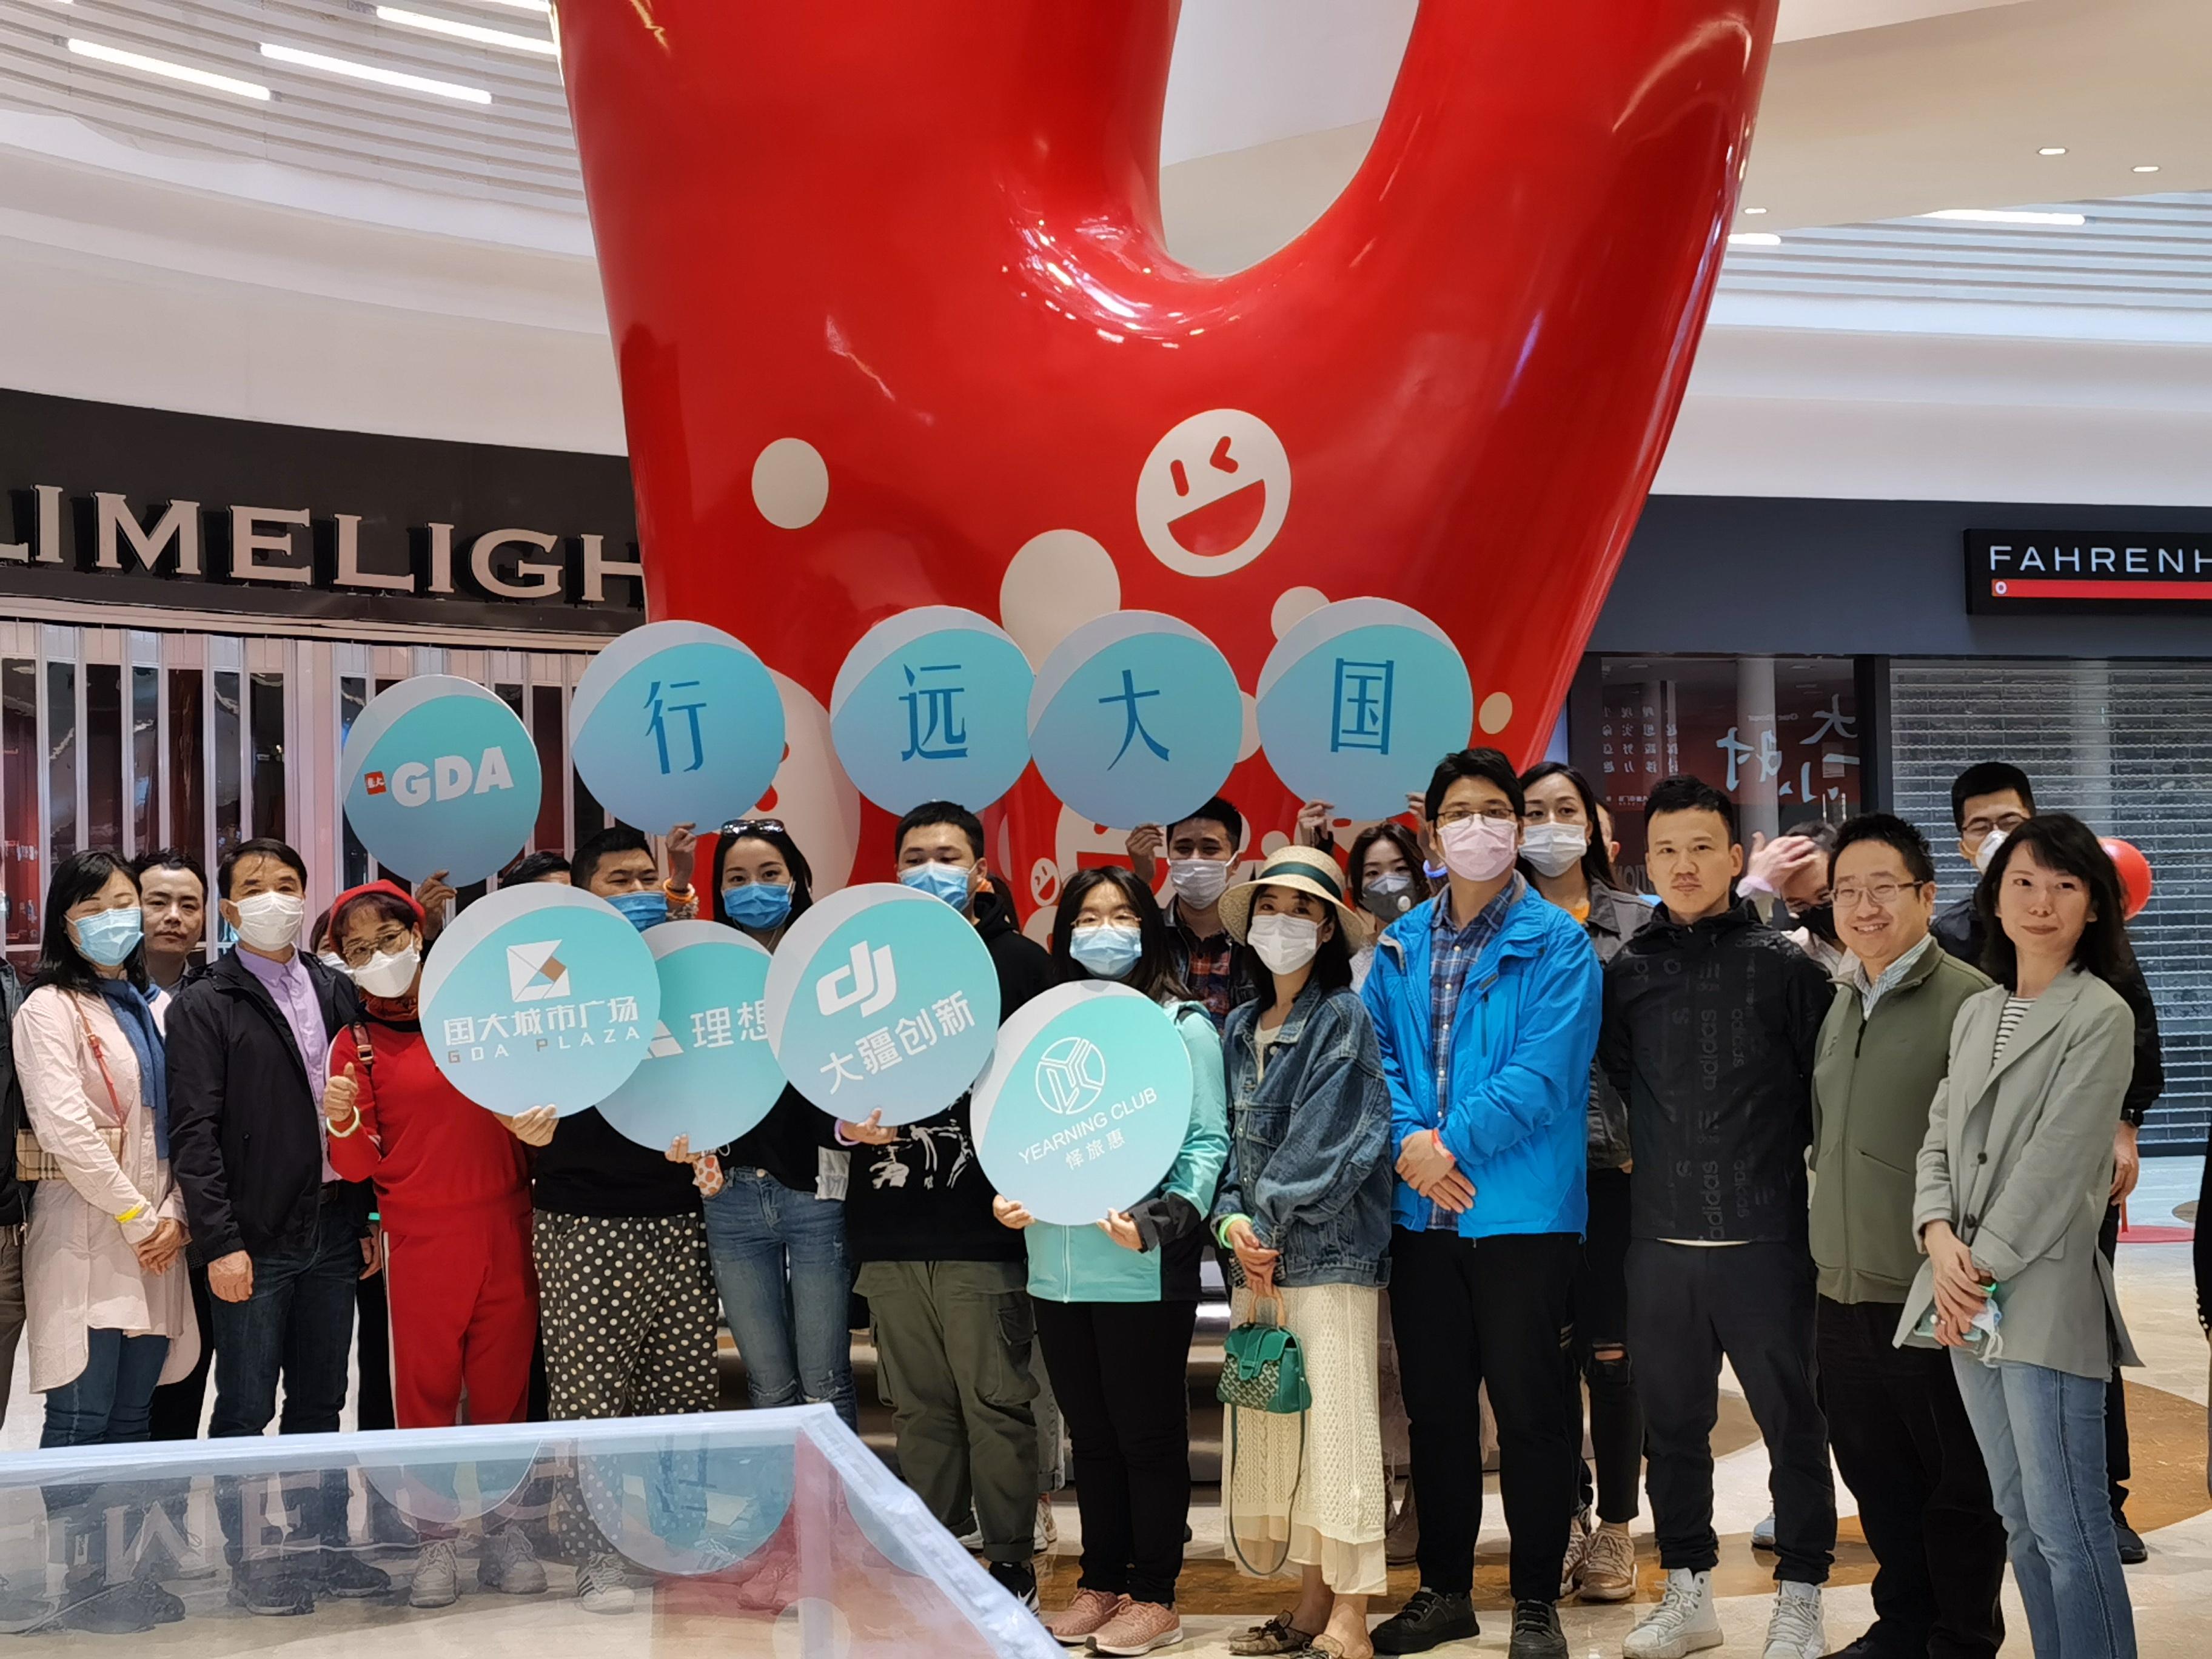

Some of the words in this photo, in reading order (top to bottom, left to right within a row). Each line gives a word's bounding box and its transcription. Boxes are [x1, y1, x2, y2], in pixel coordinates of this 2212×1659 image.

[391, 745, 515, 808] GDA
[443, 996, 638, 1046] 国大城市广场
[448, 1044, 509, 1064] GDA
[536, 1026, 640, 1053] PLAZA
[819, 990, 976, 1095] 大疆创新
[1018, 1112, 1108, 1165] YEARNING
[1110, 1087, 1158, 1120] CLUB
